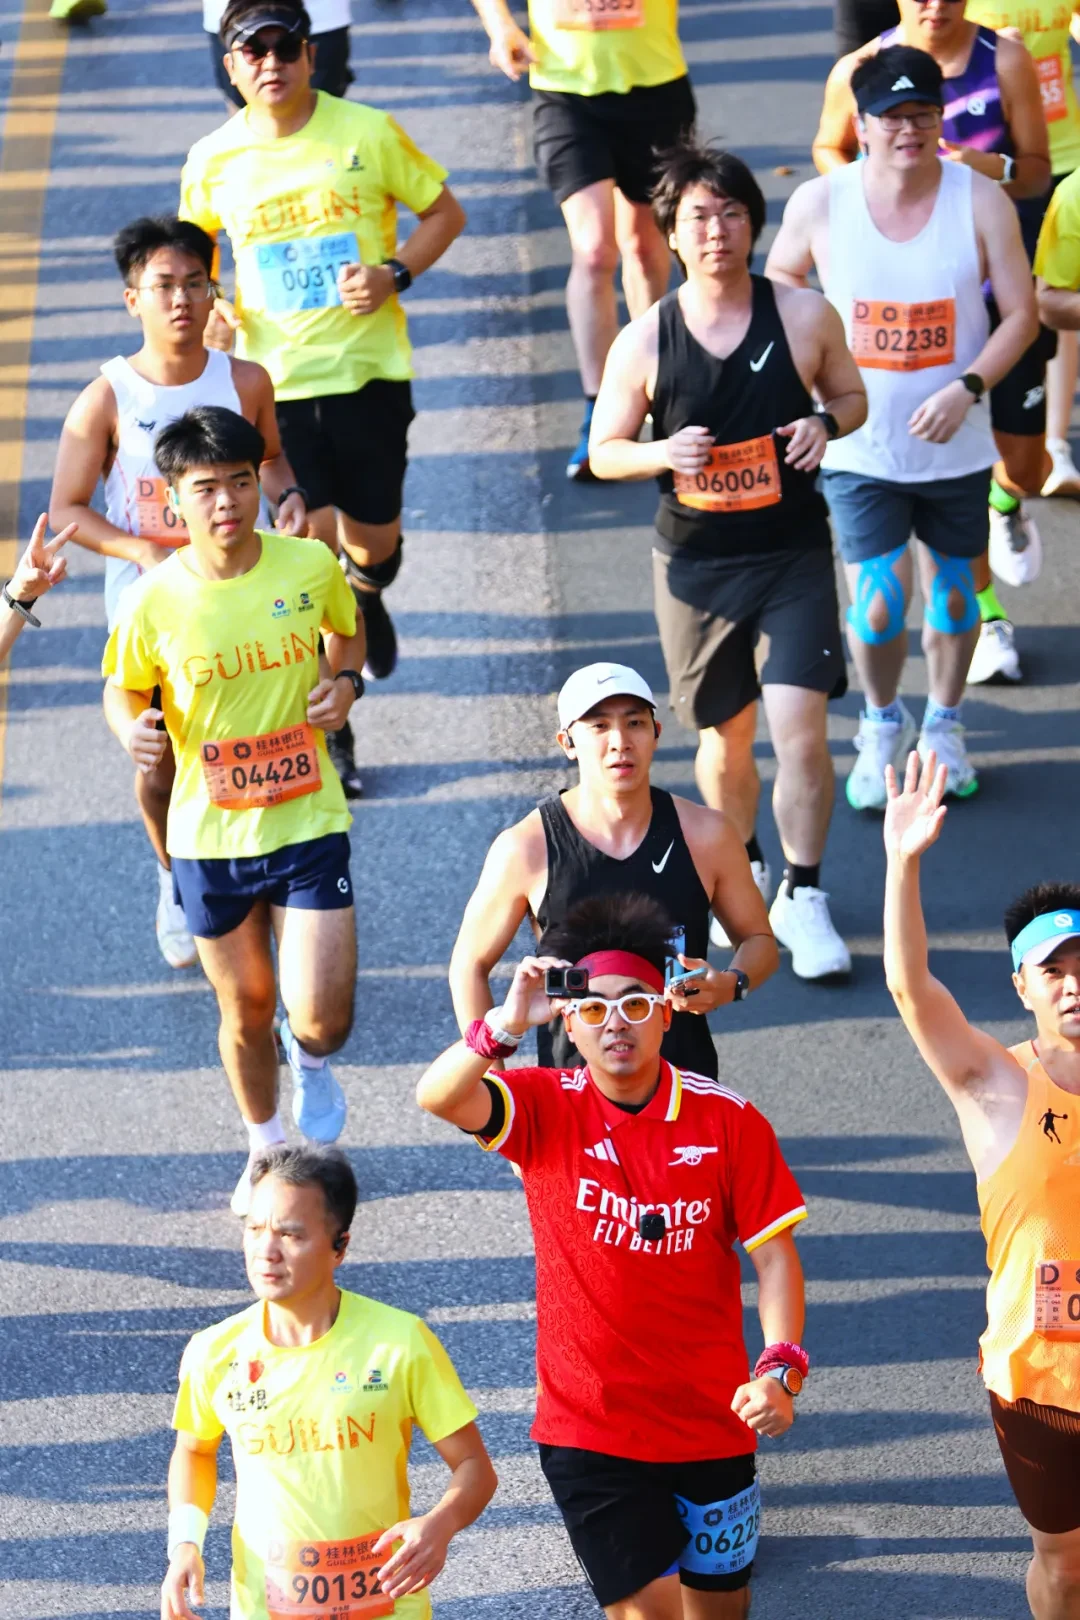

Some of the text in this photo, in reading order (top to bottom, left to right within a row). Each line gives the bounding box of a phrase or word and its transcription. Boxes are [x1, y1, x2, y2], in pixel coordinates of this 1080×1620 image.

[855, 302, 869, 319] D
[875, 326, 947, 351] 02238
[139, 480, 154, 497] D
[695, 464, 771, 493] 06004
[203, 743, 220, 762] D
[256, 728, 305, 751] 桂林银行
[231, 752, 312, 790] 04428
[576, 1177, 712, 1230] Emirates
[593, 1218, 627, 1247] FLY
[1041, 1263, 1060, 1285] D
[727, 1485, 760, 1515] 桂林银
[292, 1566, 383, 1604] 90132
